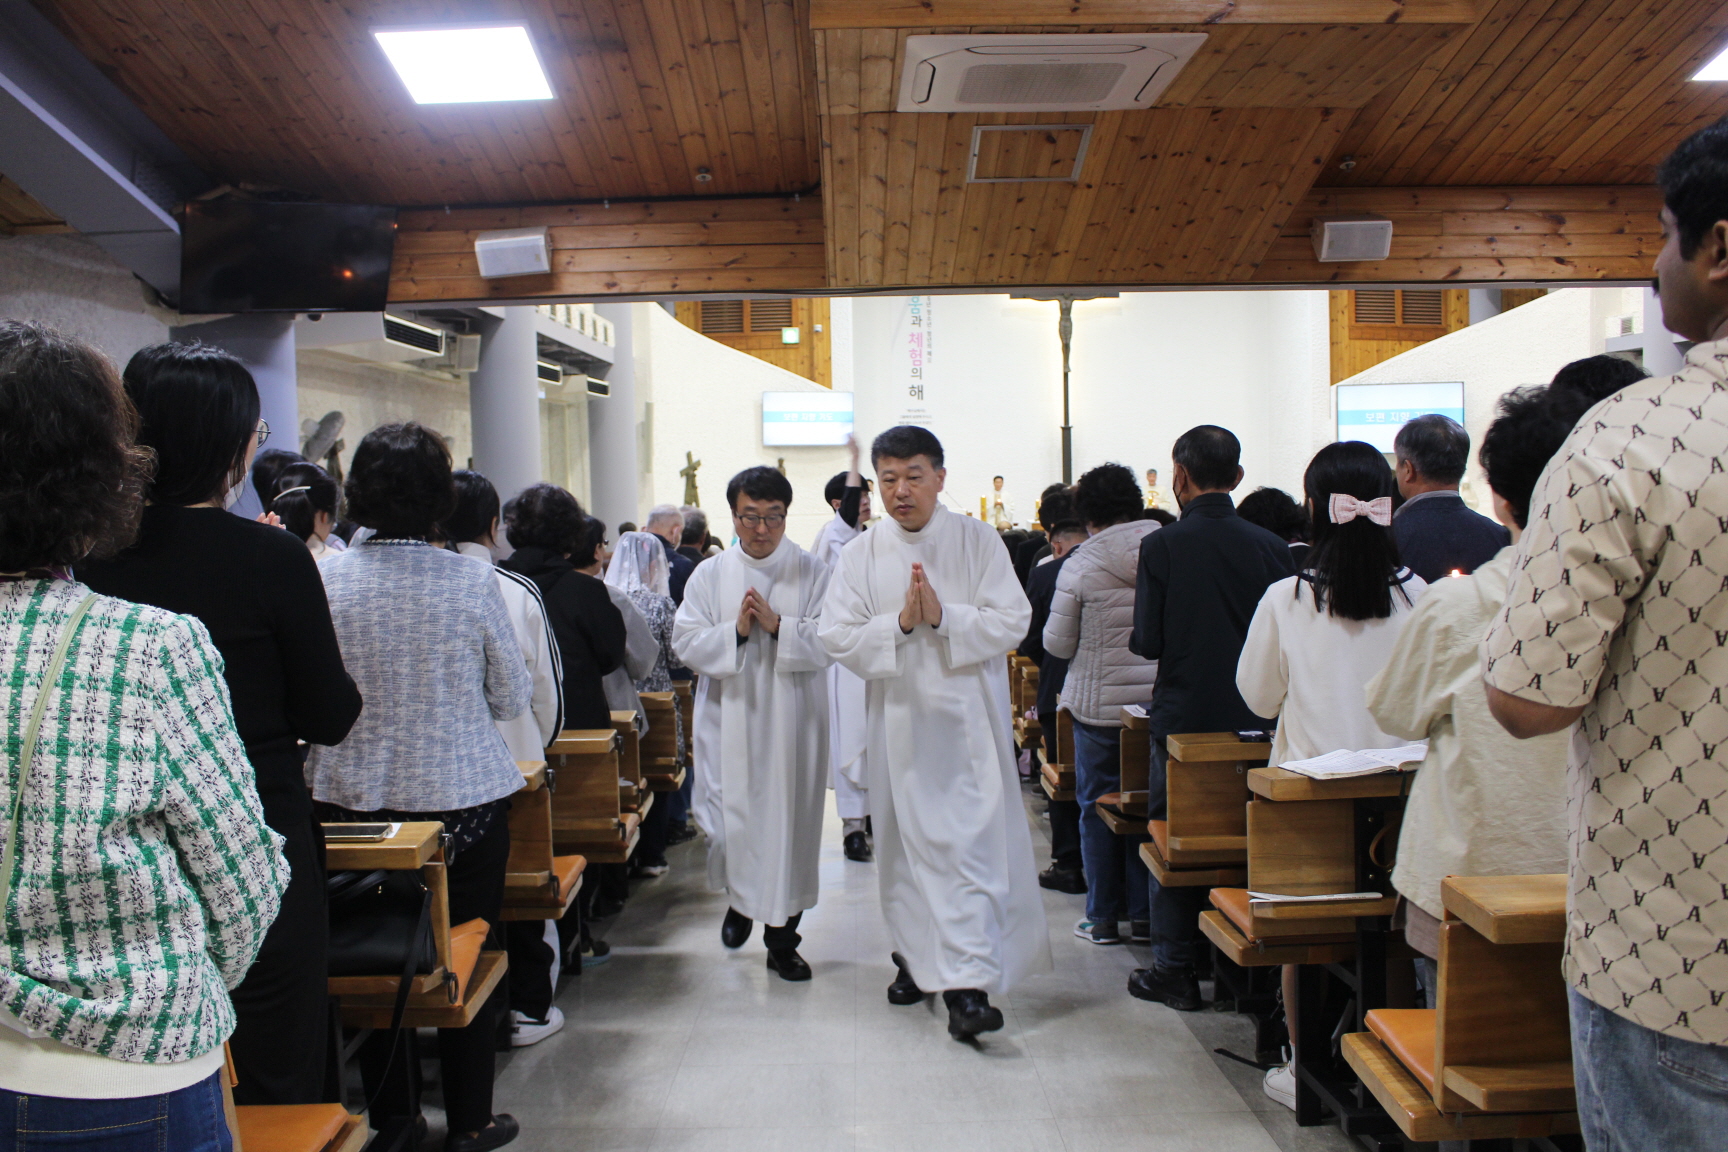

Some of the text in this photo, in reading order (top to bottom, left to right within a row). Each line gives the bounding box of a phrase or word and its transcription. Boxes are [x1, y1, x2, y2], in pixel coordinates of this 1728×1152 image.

[908, 332, 923, 380] 체험의
[908, 384, 924, 401] 해
[1365, 412, 1385, 423] 보편
[1390, 411, 1411, 423] 지향
